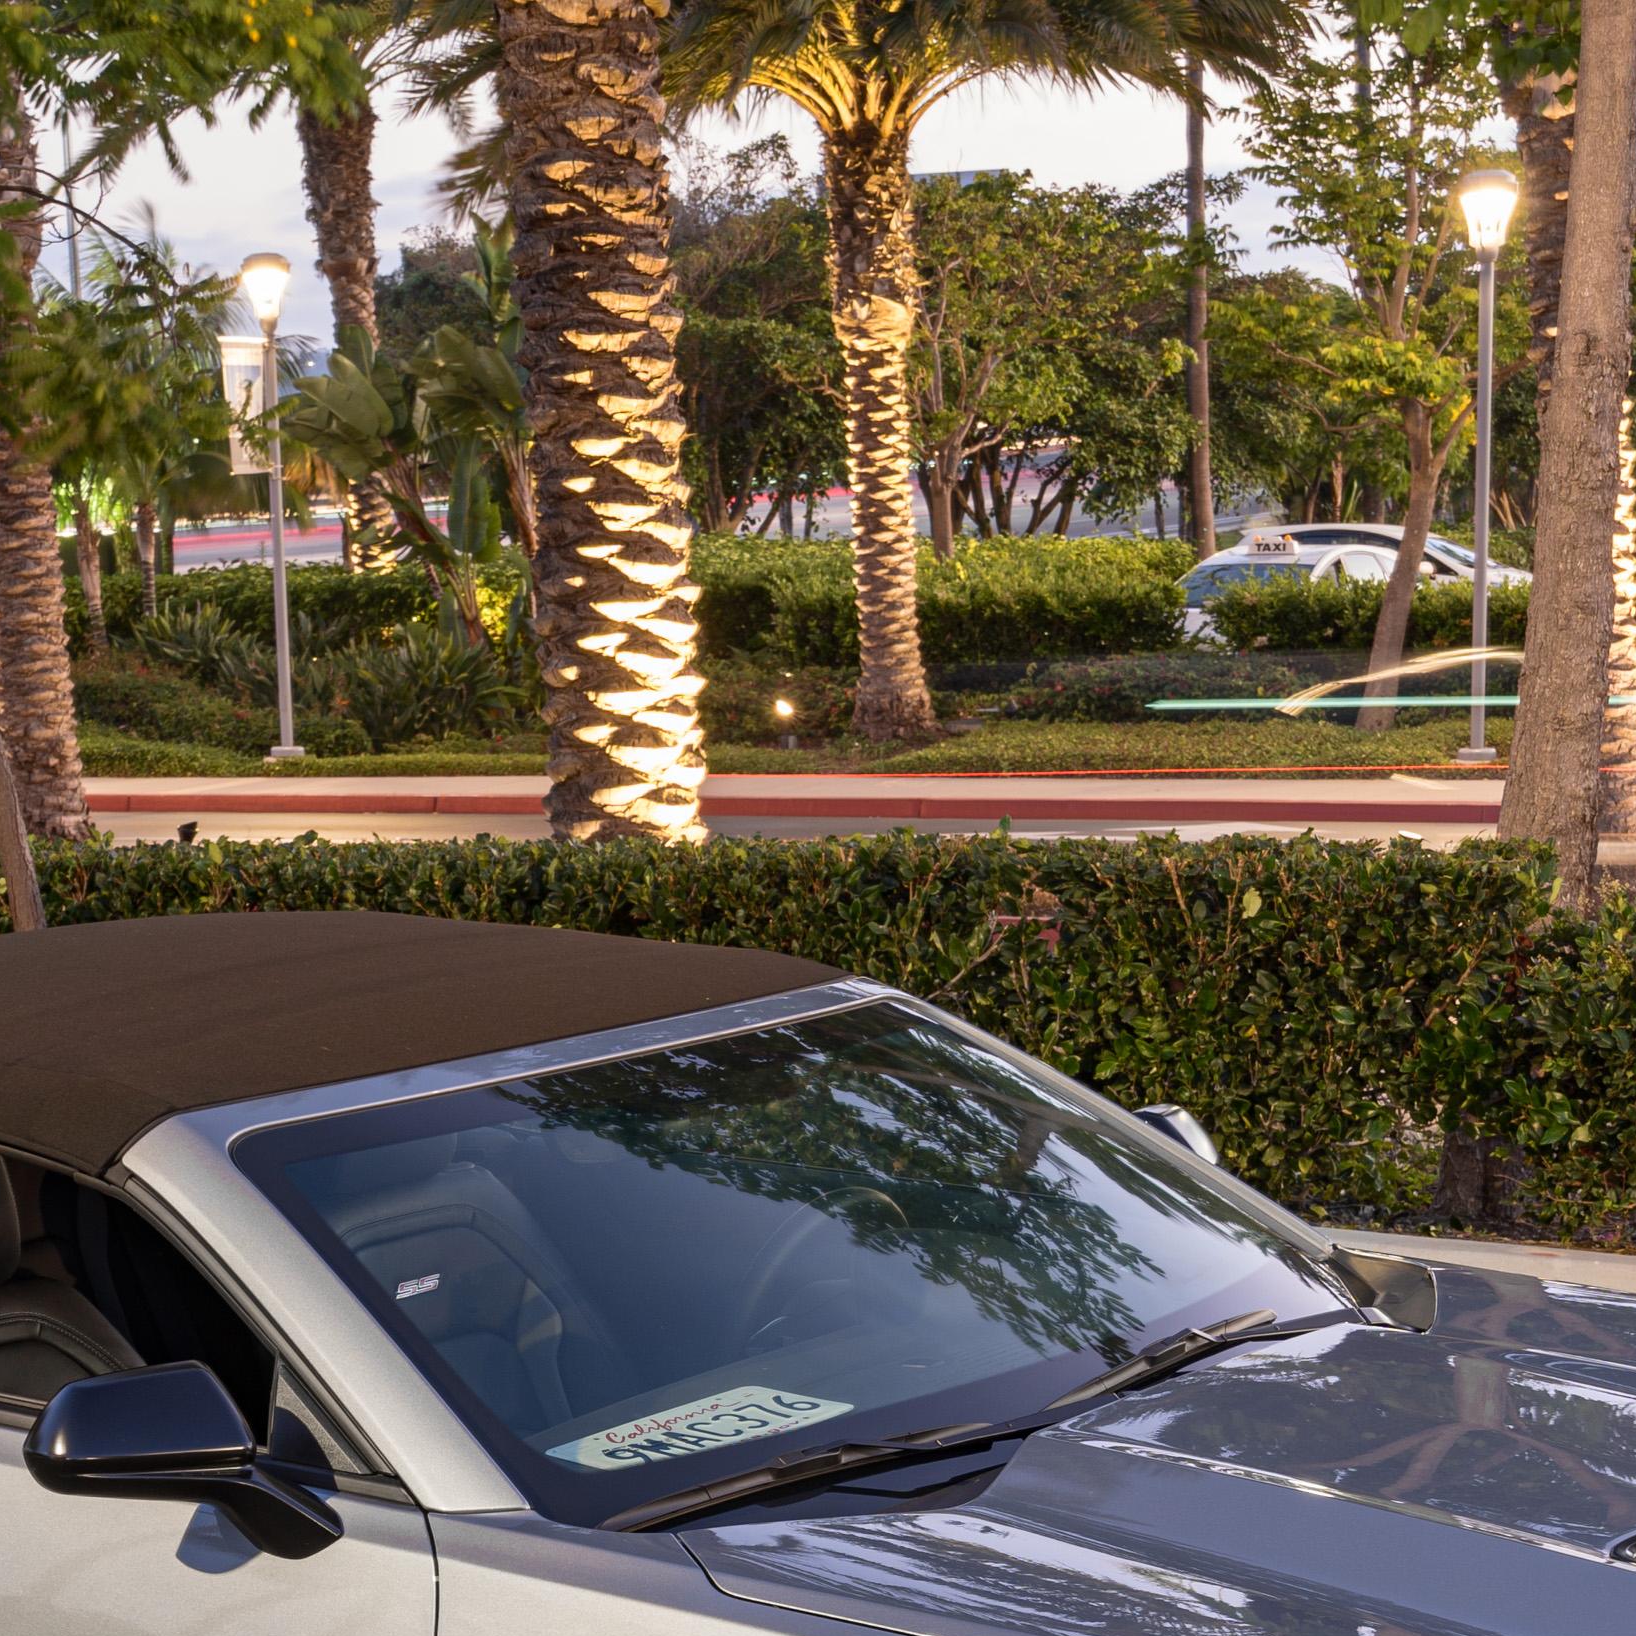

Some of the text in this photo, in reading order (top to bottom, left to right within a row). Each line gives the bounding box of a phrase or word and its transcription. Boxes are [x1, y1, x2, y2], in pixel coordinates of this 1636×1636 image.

[1254, 541, 1287, 553] TAXI
[395, 1272, 441, 1300] SS
[604, 1394, 821, 1464] 9MAC376
[605, 1401, 741, 1444] California
